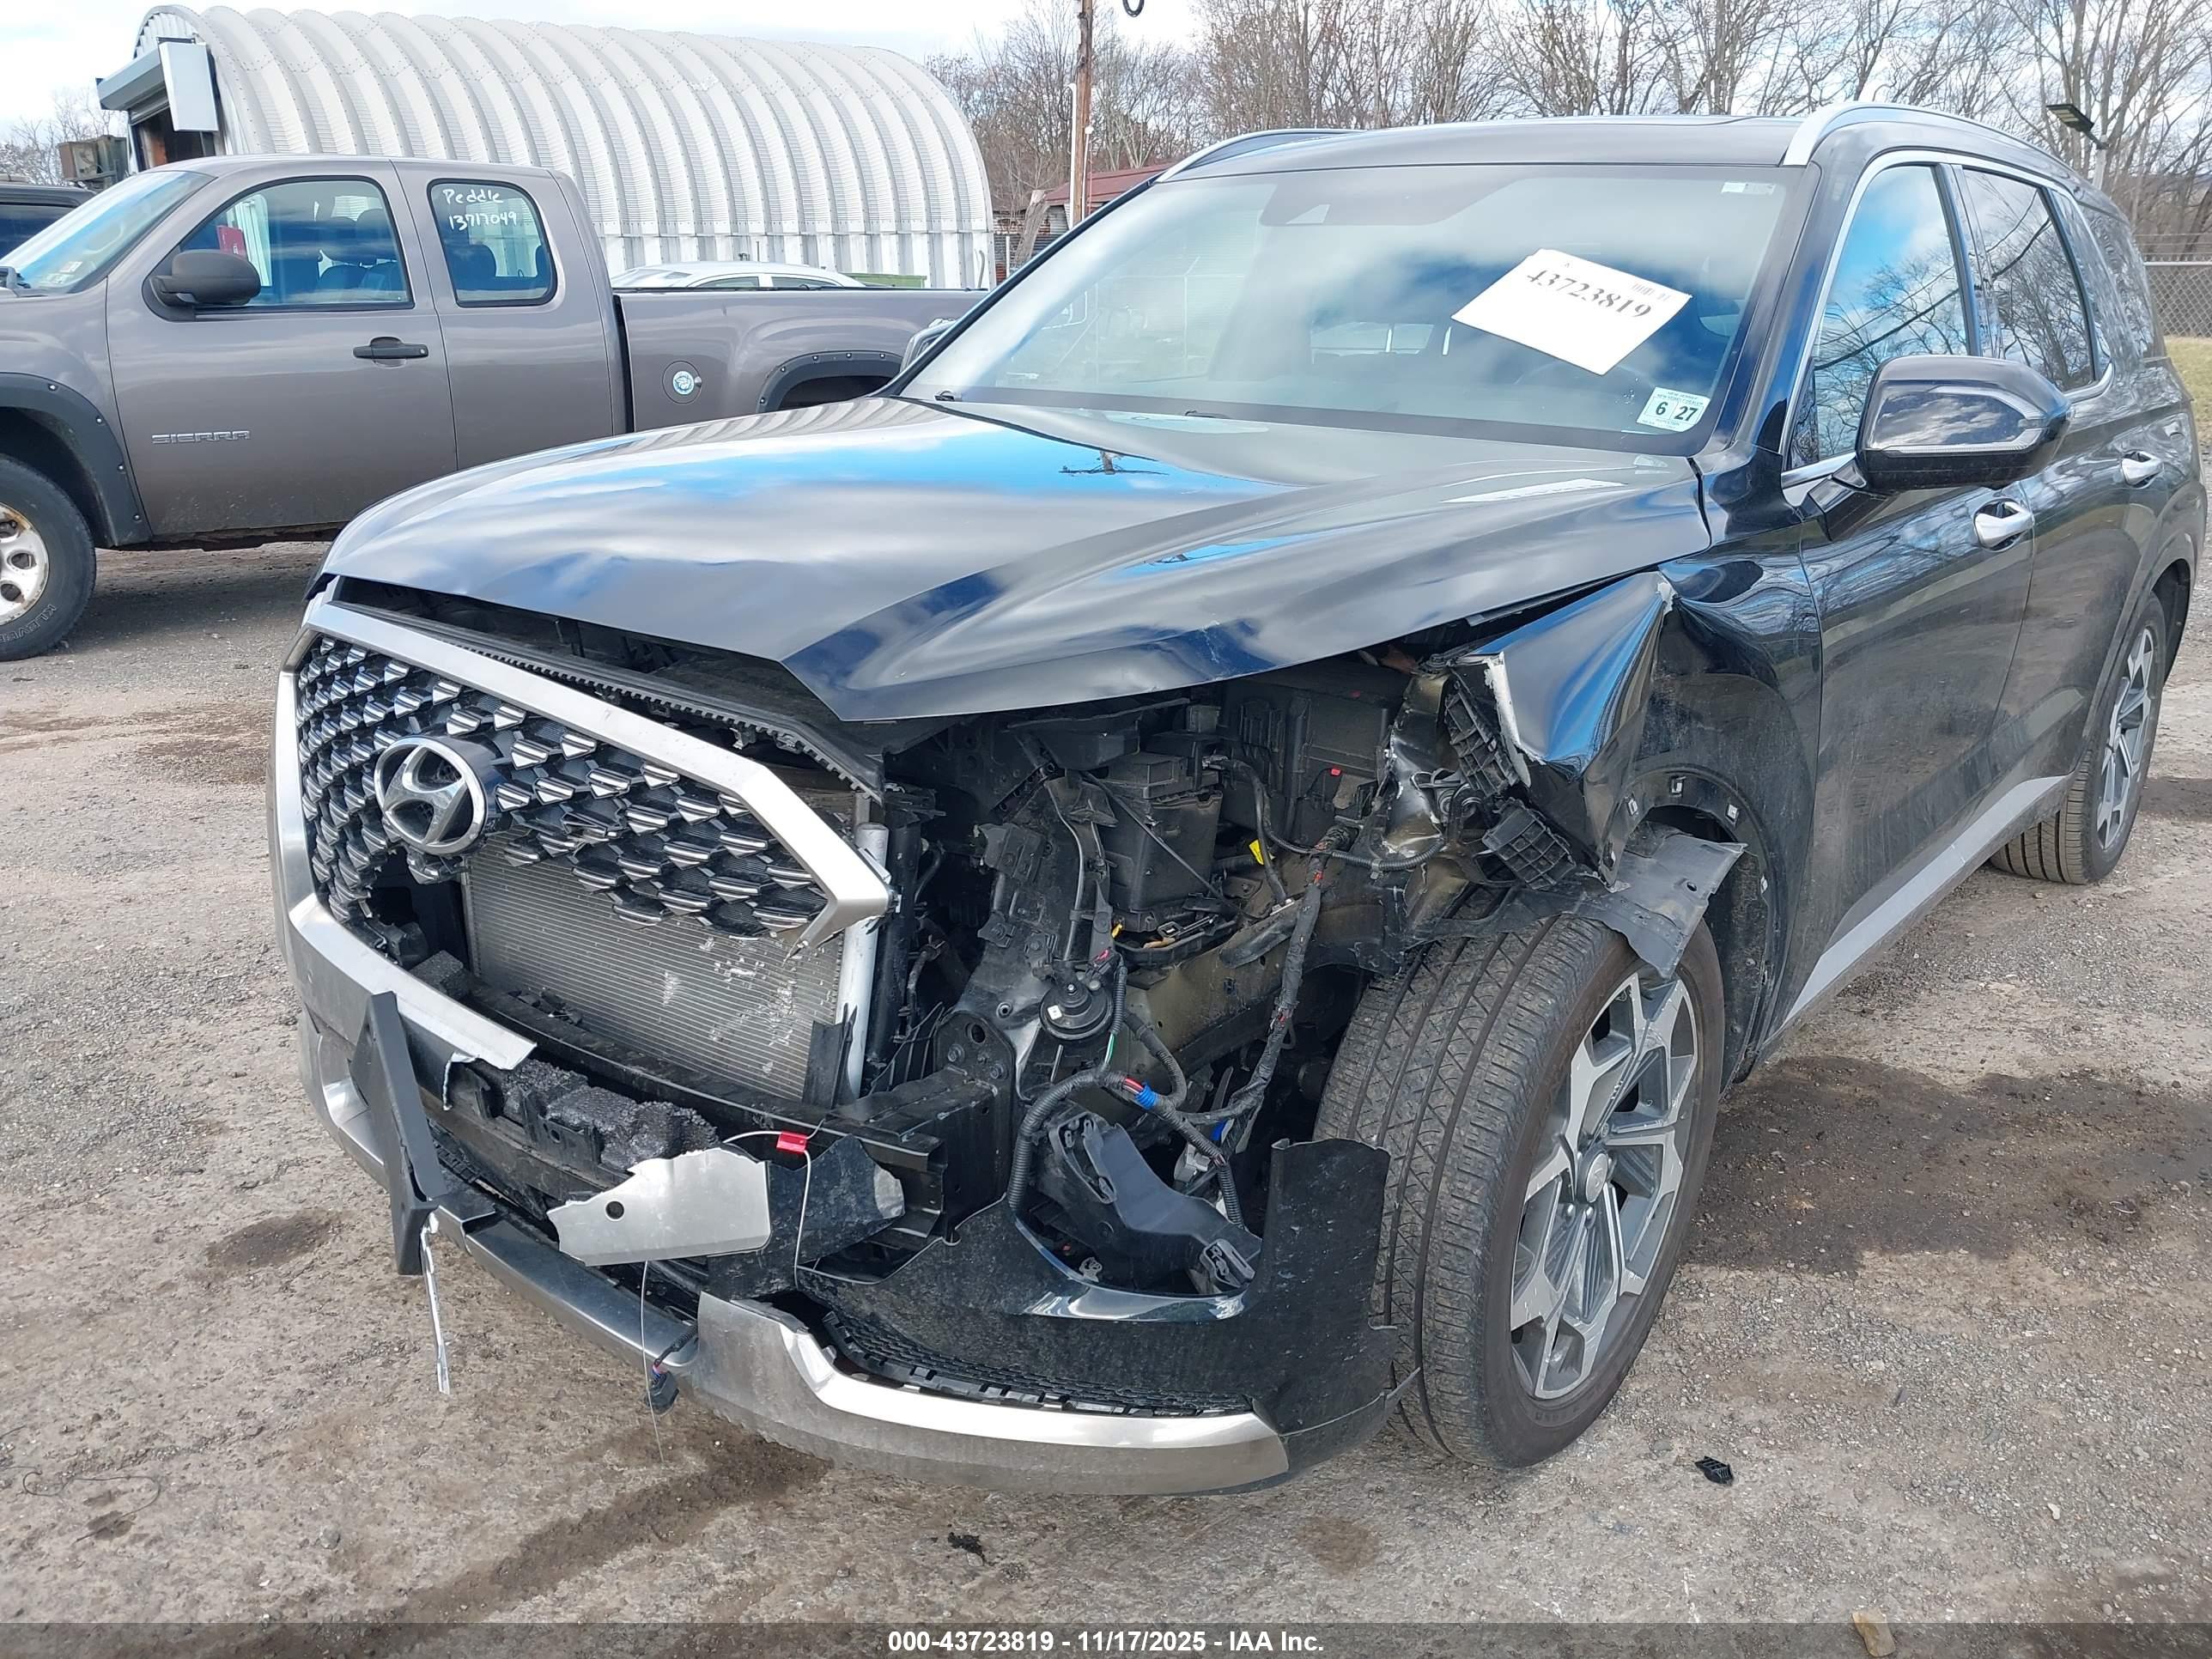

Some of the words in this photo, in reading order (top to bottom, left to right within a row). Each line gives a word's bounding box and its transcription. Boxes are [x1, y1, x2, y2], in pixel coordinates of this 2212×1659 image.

[442, 188, 504, 204] Peddle
[448, 211, 517, 231] 13717049
[1527, 270, 1651, 318] 43723819
[1656, 401, 1668, 416] 6
[1674, 405, 1698, 422] 27
[151, 430, 251, 444] SIERRA
